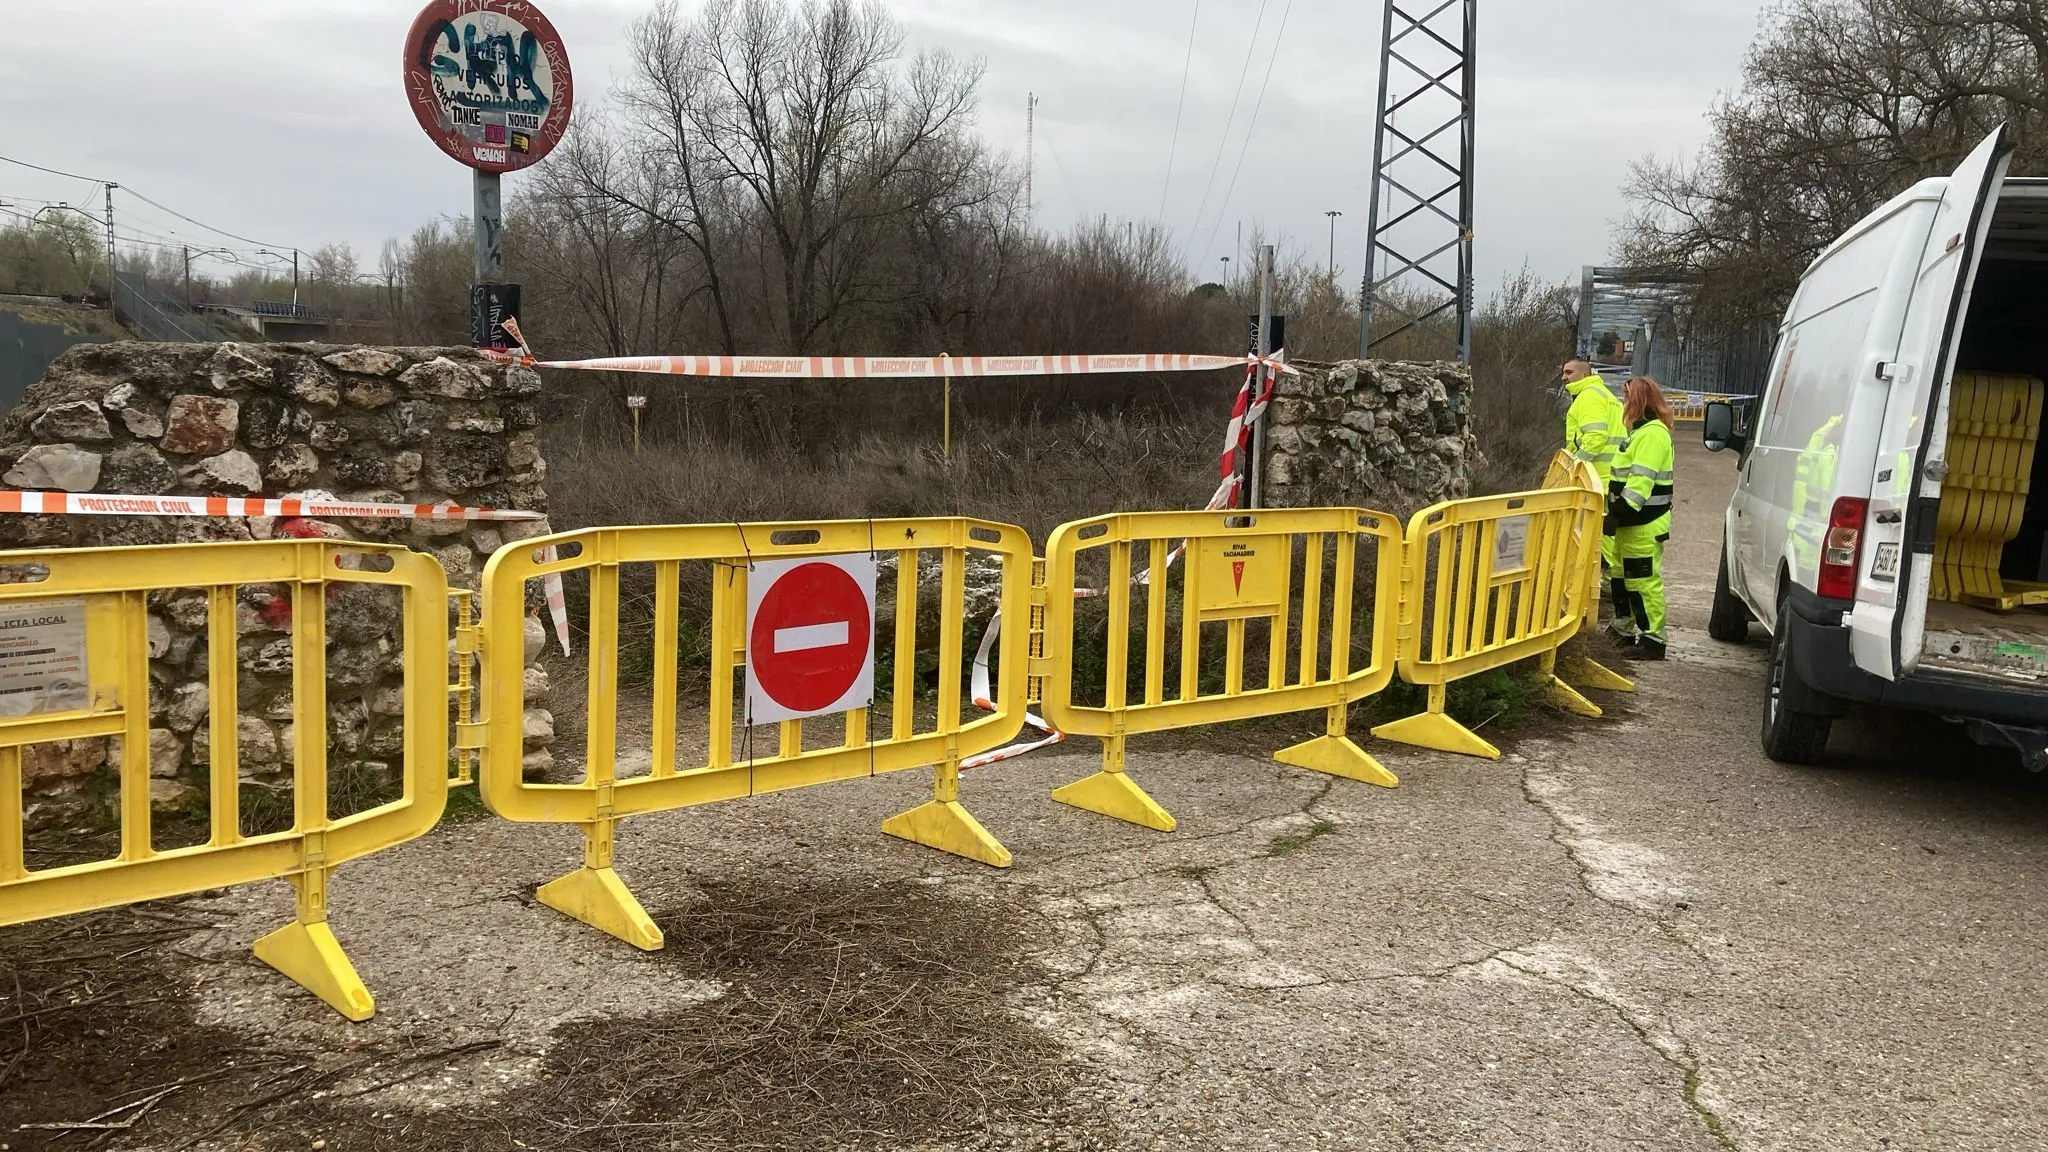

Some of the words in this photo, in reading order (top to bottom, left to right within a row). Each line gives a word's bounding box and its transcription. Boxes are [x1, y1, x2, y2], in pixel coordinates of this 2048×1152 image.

[452, 106, 480, 125] TANKE
[508, 113, 539, 129] NOMAH
[78, 498, 160, 513] PROTECCION
[161, 501, 195, 514] CIVIL
[0, 619, 29, 629] ICIA
[32, 615, 67, 627] LOCAL
